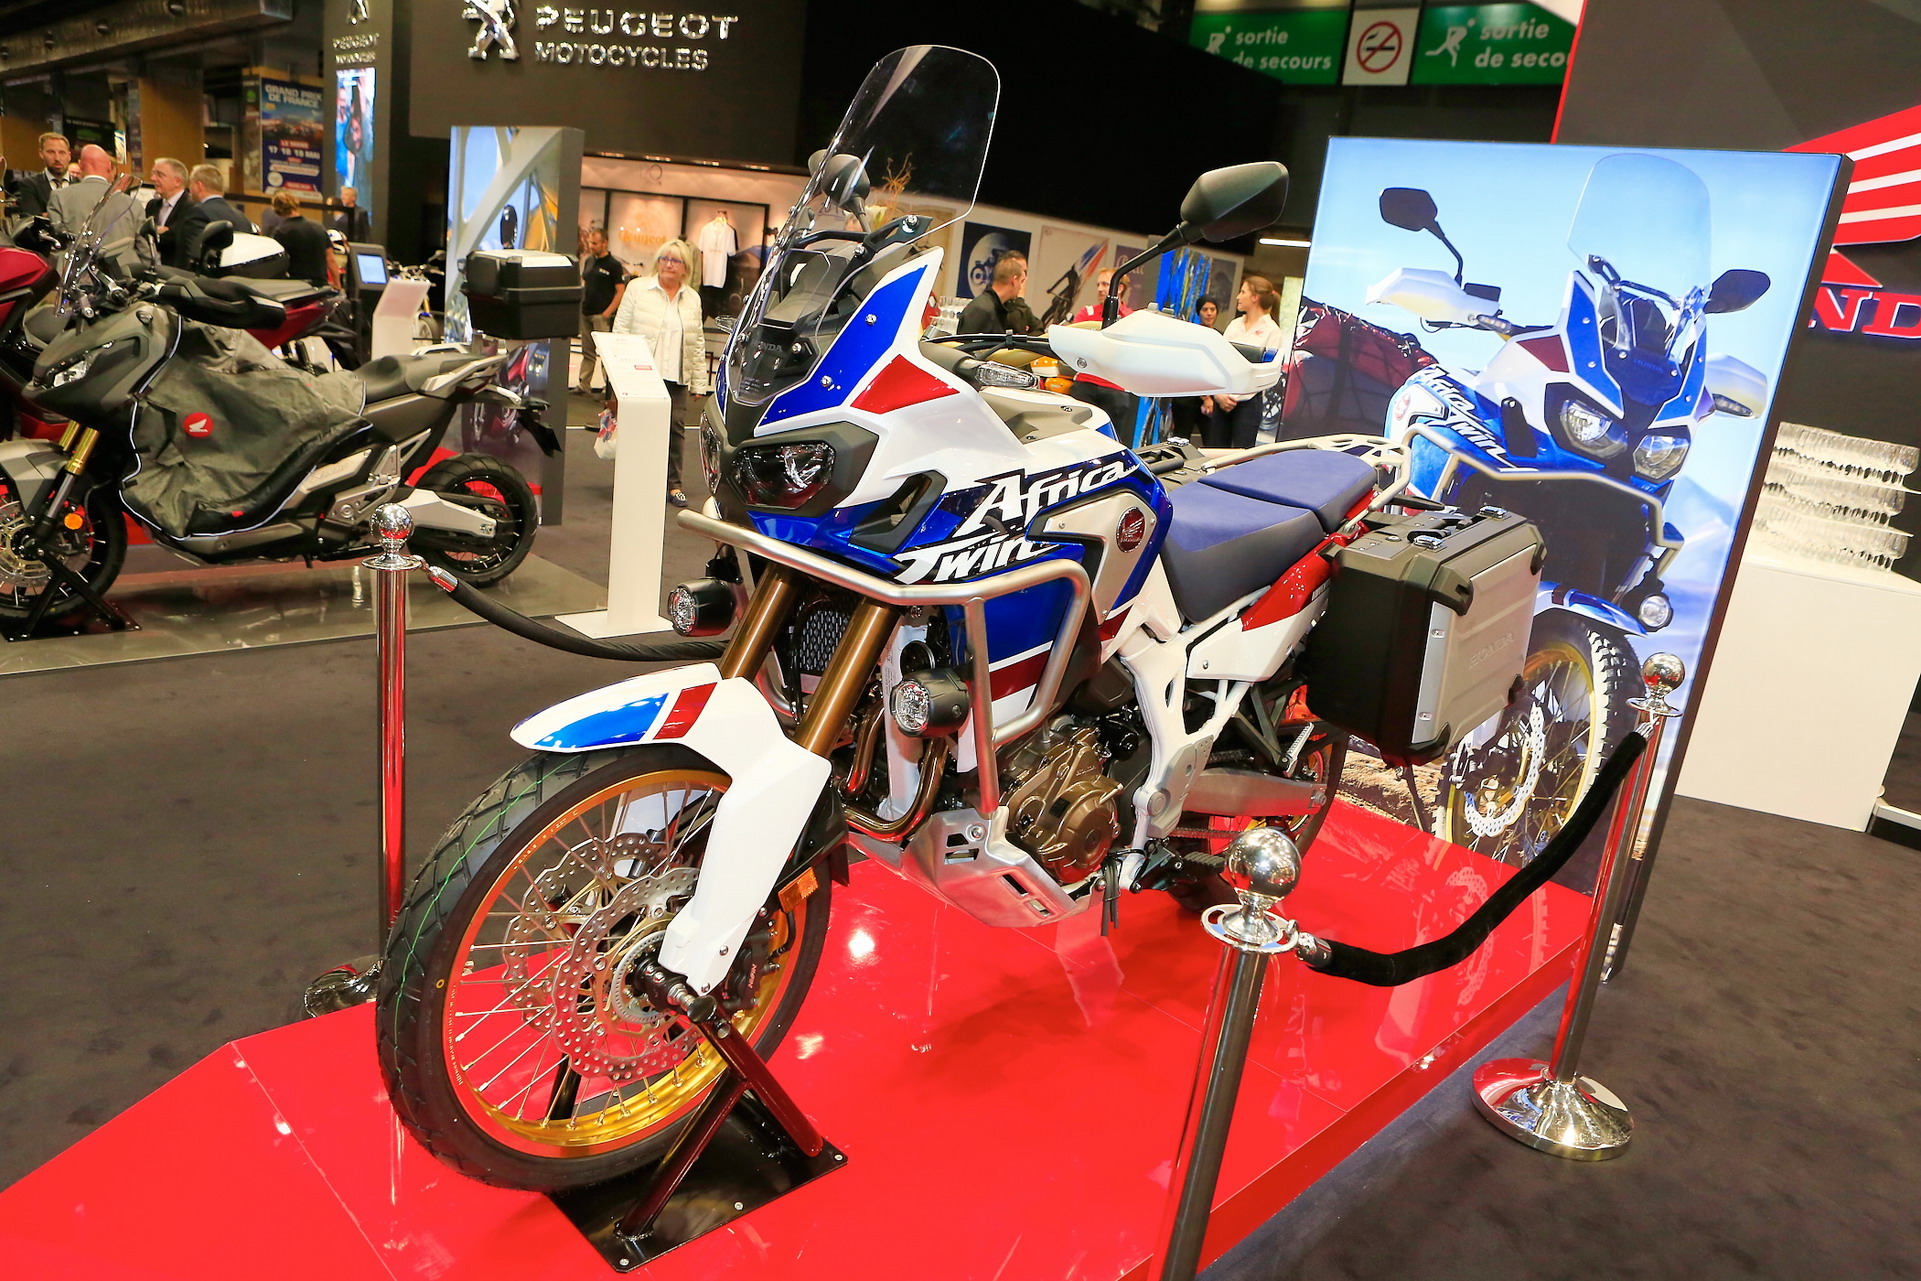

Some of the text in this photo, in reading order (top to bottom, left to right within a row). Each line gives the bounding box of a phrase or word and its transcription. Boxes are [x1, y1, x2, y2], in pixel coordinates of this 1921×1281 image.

[536, 5, 739, 40] PEUGEOT
[1480, 17, 1549, 40] sortie
[1235, 26, 1289, 45] sortie
[535, 41, 709, 71] MOTOCYCLES
[1259, 55, 1332, 69] secours
[1475, 46, 1569, 67] de seco
[265, 84, 322, 101] GRAND PRIX
[283, 95, 318, 108] FRANCE
[952, 460, 1141, 538] Africa
[893, 531, 1060, 585] Twin
